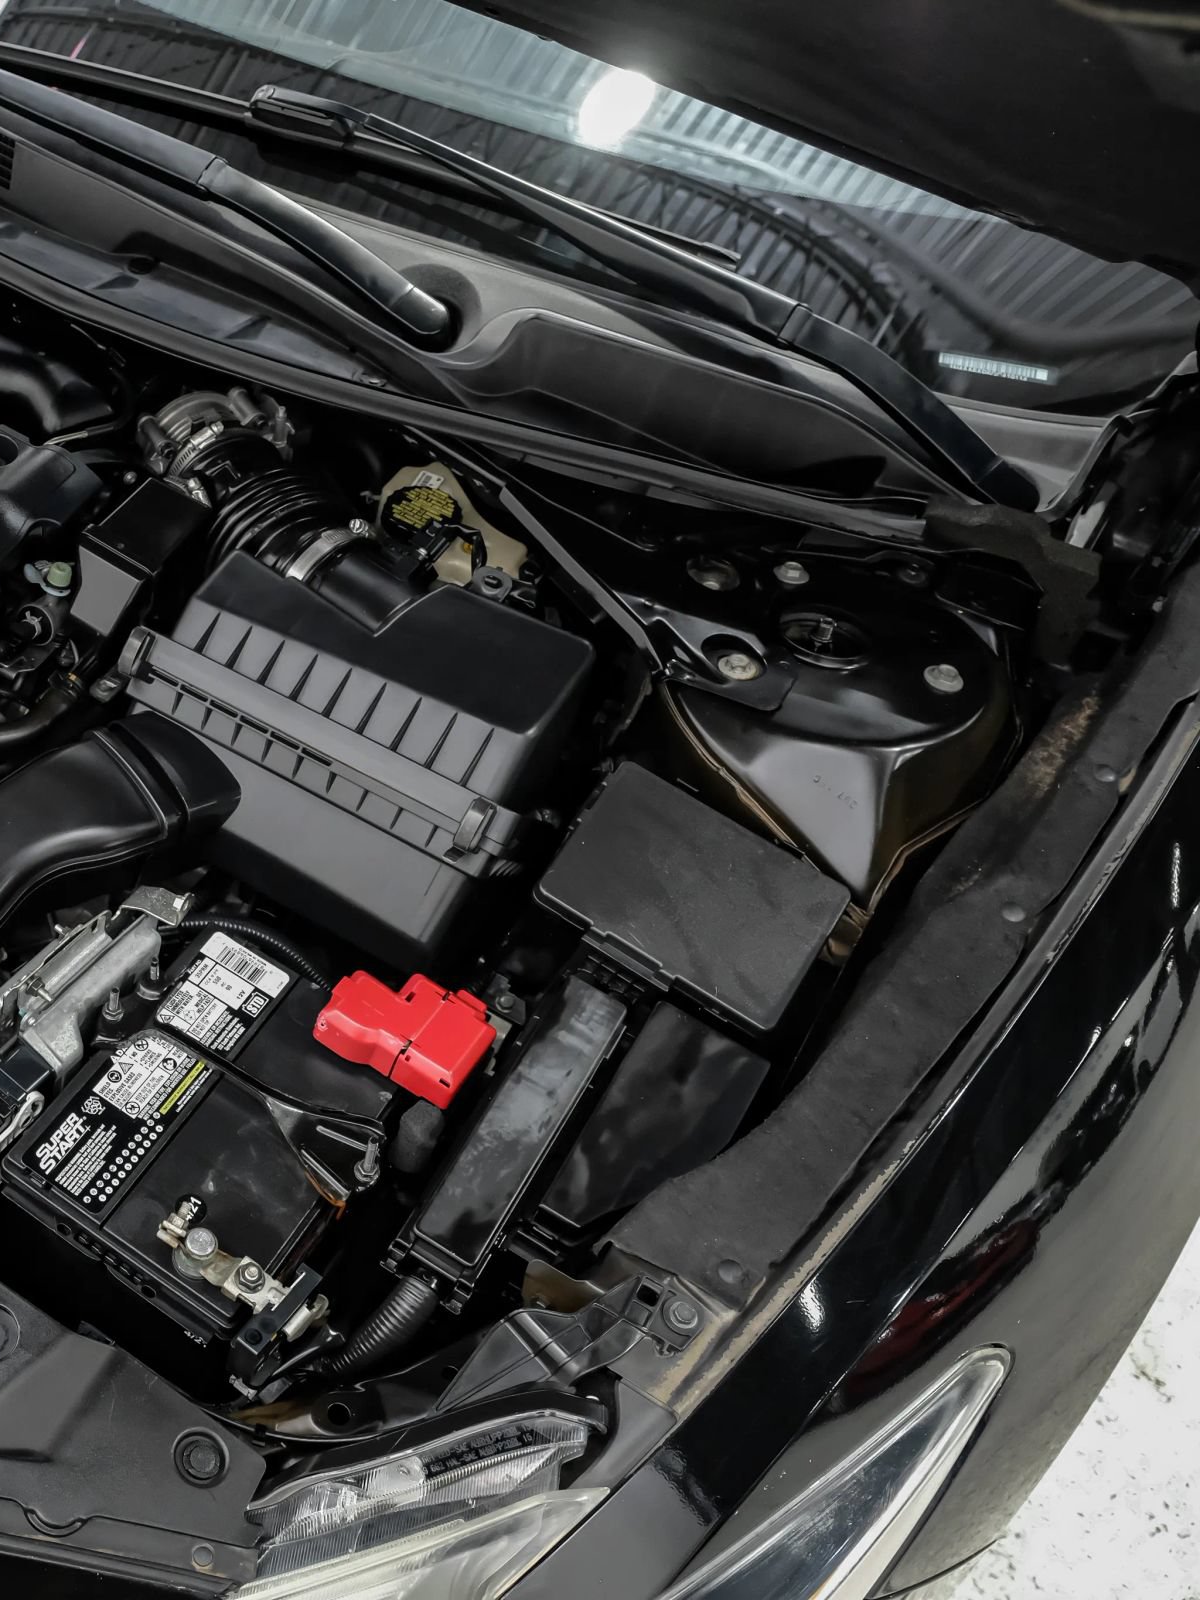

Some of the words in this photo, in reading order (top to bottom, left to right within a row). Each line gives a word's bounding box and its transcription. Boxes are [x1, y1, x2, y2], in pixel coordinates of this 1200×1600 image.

[236, 989, 247, 1000] 12V
[246, 995, 266, 1014] STD
[98, 1081, 112, 1095] SHIELD
[35, 1112, 80, 1161] SUPER
[38, 1116, 87, 1175] START
